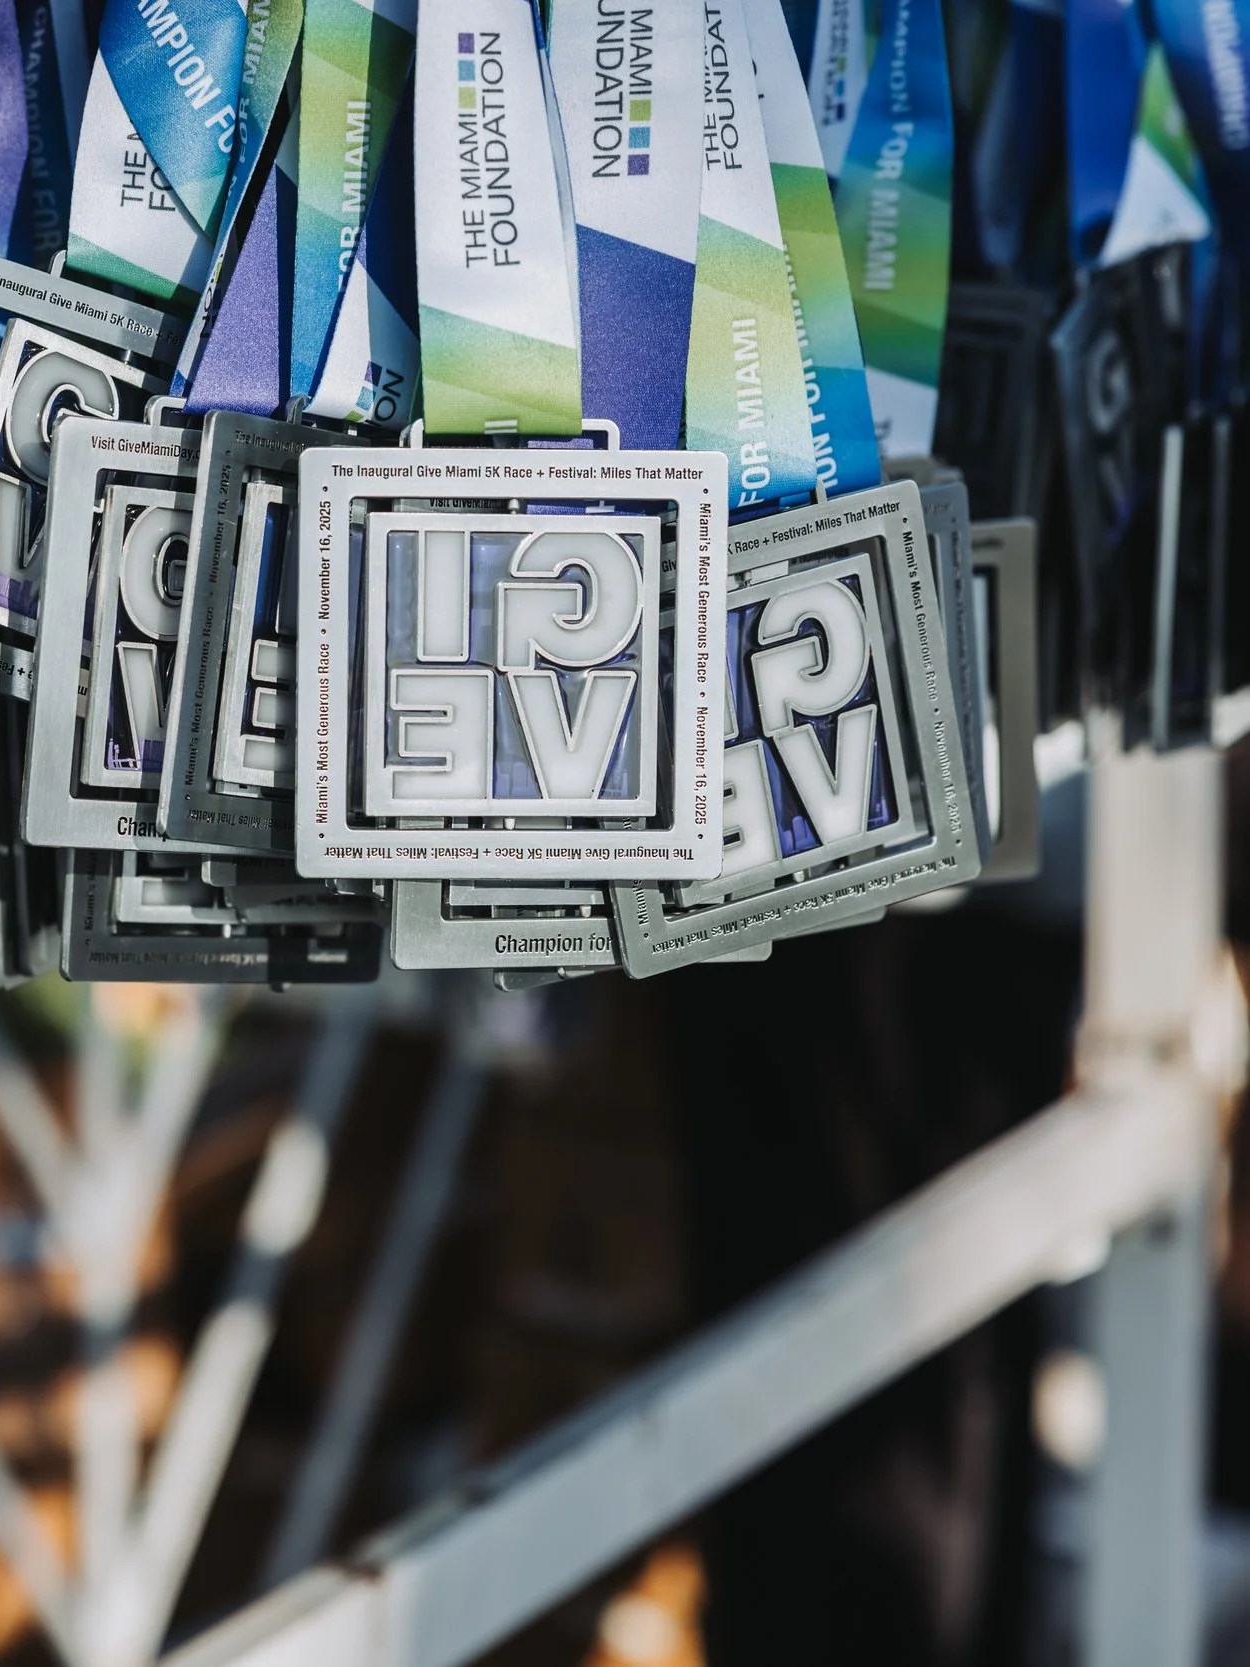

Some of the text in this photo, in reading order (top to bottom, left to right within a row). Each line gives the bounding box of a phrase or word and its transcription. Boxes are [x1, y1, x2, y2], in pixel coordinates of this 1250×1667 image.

[629, 9, 654, 95] MIAMI
[342, 100, 372, 213] MIAMI
[479, 32, 521, 267] FOUNDATION
[704, 113, 722, 171] THE
[120, 150, 147, 207] THE
[458, 113, 488, 269] THE MIAMI
[862, 187, 901, 290] MIAMI
[49, 292, 79, 311] Give
[74, 301, 109, 322] Miami
[109, 312, 127, 329] 5K
[126, 318, 154, 337] Race
[732, 318, 771, 507] FOR MIAMI
[91, 435, 115, 450] Visit
[332, 464, 704, 481] The Inaugural Give Miami 5K Race + Festival: Miles That Matter
[735, 538, 760, 554] Race
[772, 523, 814, 544] Festival:
[815, 515, 842, 532] Miles
[843, 509, 867, 525] That
[868, 501, 901, 519] Matter
[902, 531, 918, 579] Miami's
[191, 702, 203, 734] Most
[208, 522, 225, 584] November
[220, 464, 232, 495] 2025
[910, 580, 924, 611] Most
[916, 612, 933, 669] Generous
[315, 500, 333, 824] Miami's Most Generous Race November 16, 2025
[694, 503, 712, 825] Miami's Most Generous Race November 16, 2025
[925, 670, 938, 701] Race
[934, 721, 951, 781] November
[216, 811, 237, 826] That
[947, 802, 962, 834] 2025
[324, 846, 695, 861] The Inaugural Give Miami 5K Race + Festival: Miles That Matter
[938, 855, 958, 868] The
[834, 882, 867, 901] Miami
[867, 875, 890, 890] Give
[891, 863, 938, 886] Inaugural
[793, 896, 820, 913] Race
[494, 932, 613, 957] Champion for
[651, 937, 686, 955] Matter
[686, 929, 711, 947] That
[711, 920, 740, 938] Miles
